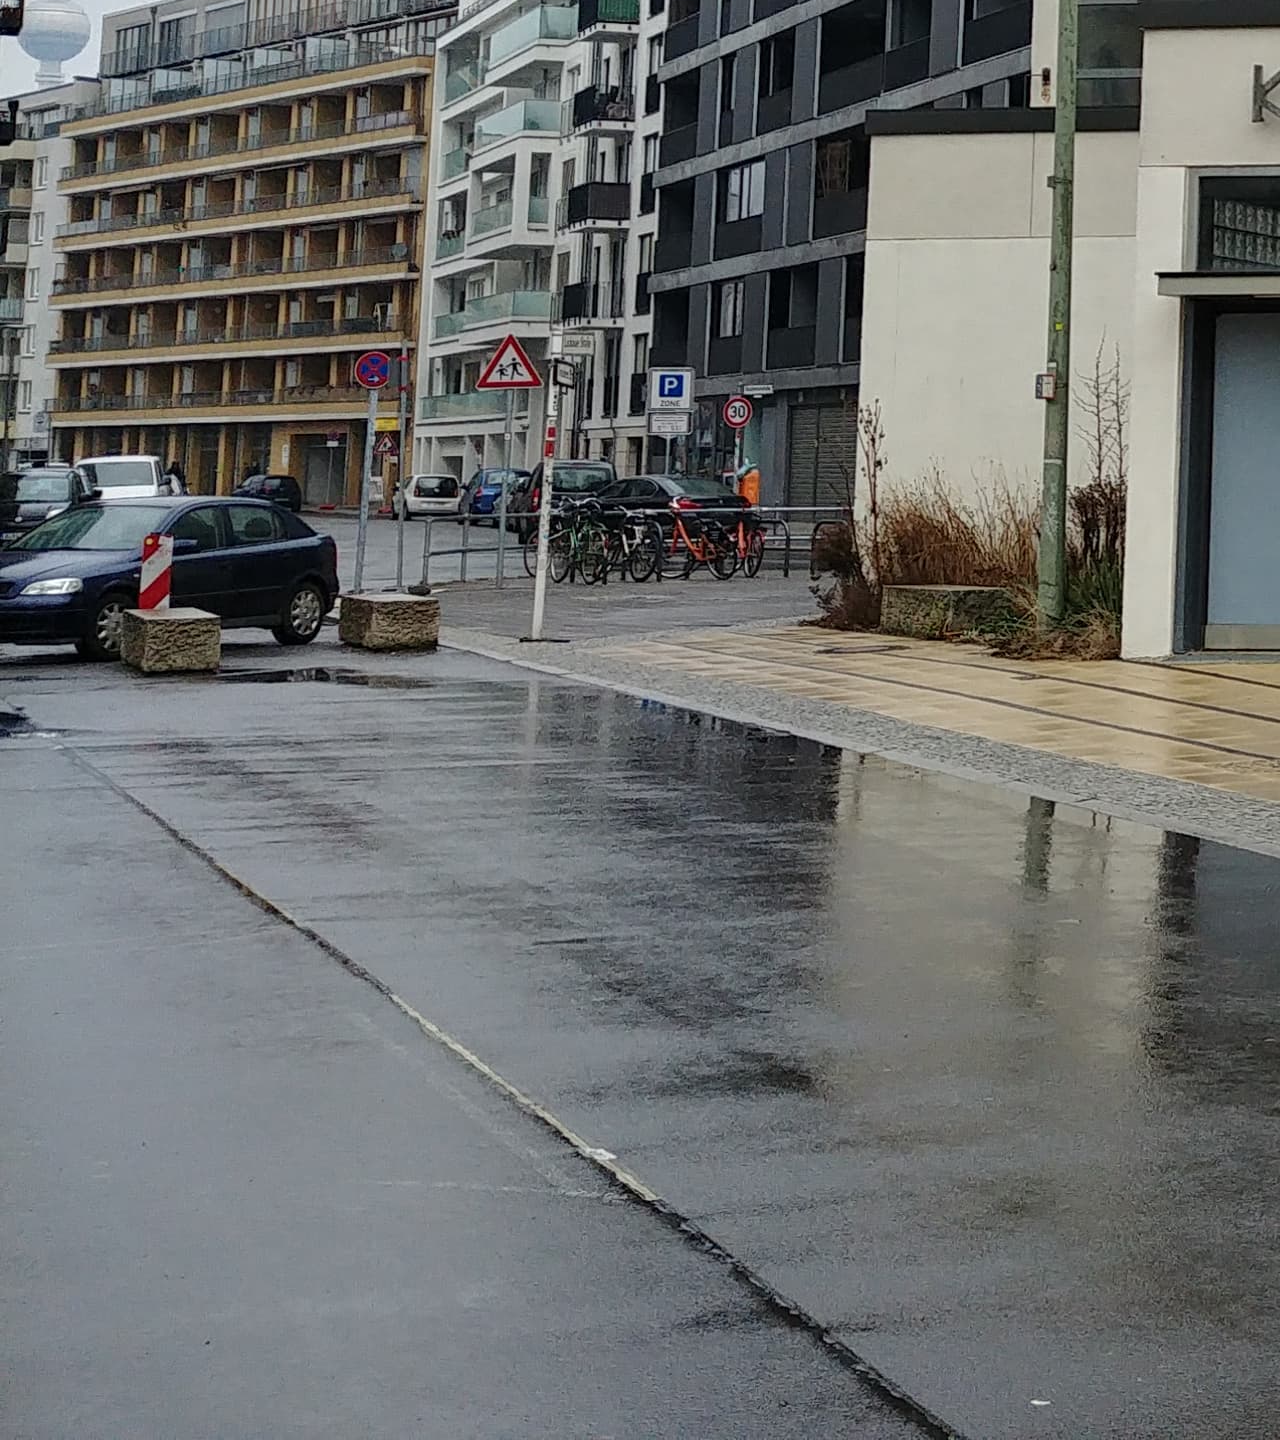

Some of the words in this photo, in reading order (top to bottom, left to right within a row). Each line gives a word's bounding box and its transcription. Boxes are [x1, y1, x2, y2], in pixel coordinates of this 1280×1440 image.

[663, 377, 679, 396] P
[659, 399, 681, 407] ZONE
[729, 405, 746, 418] 30
